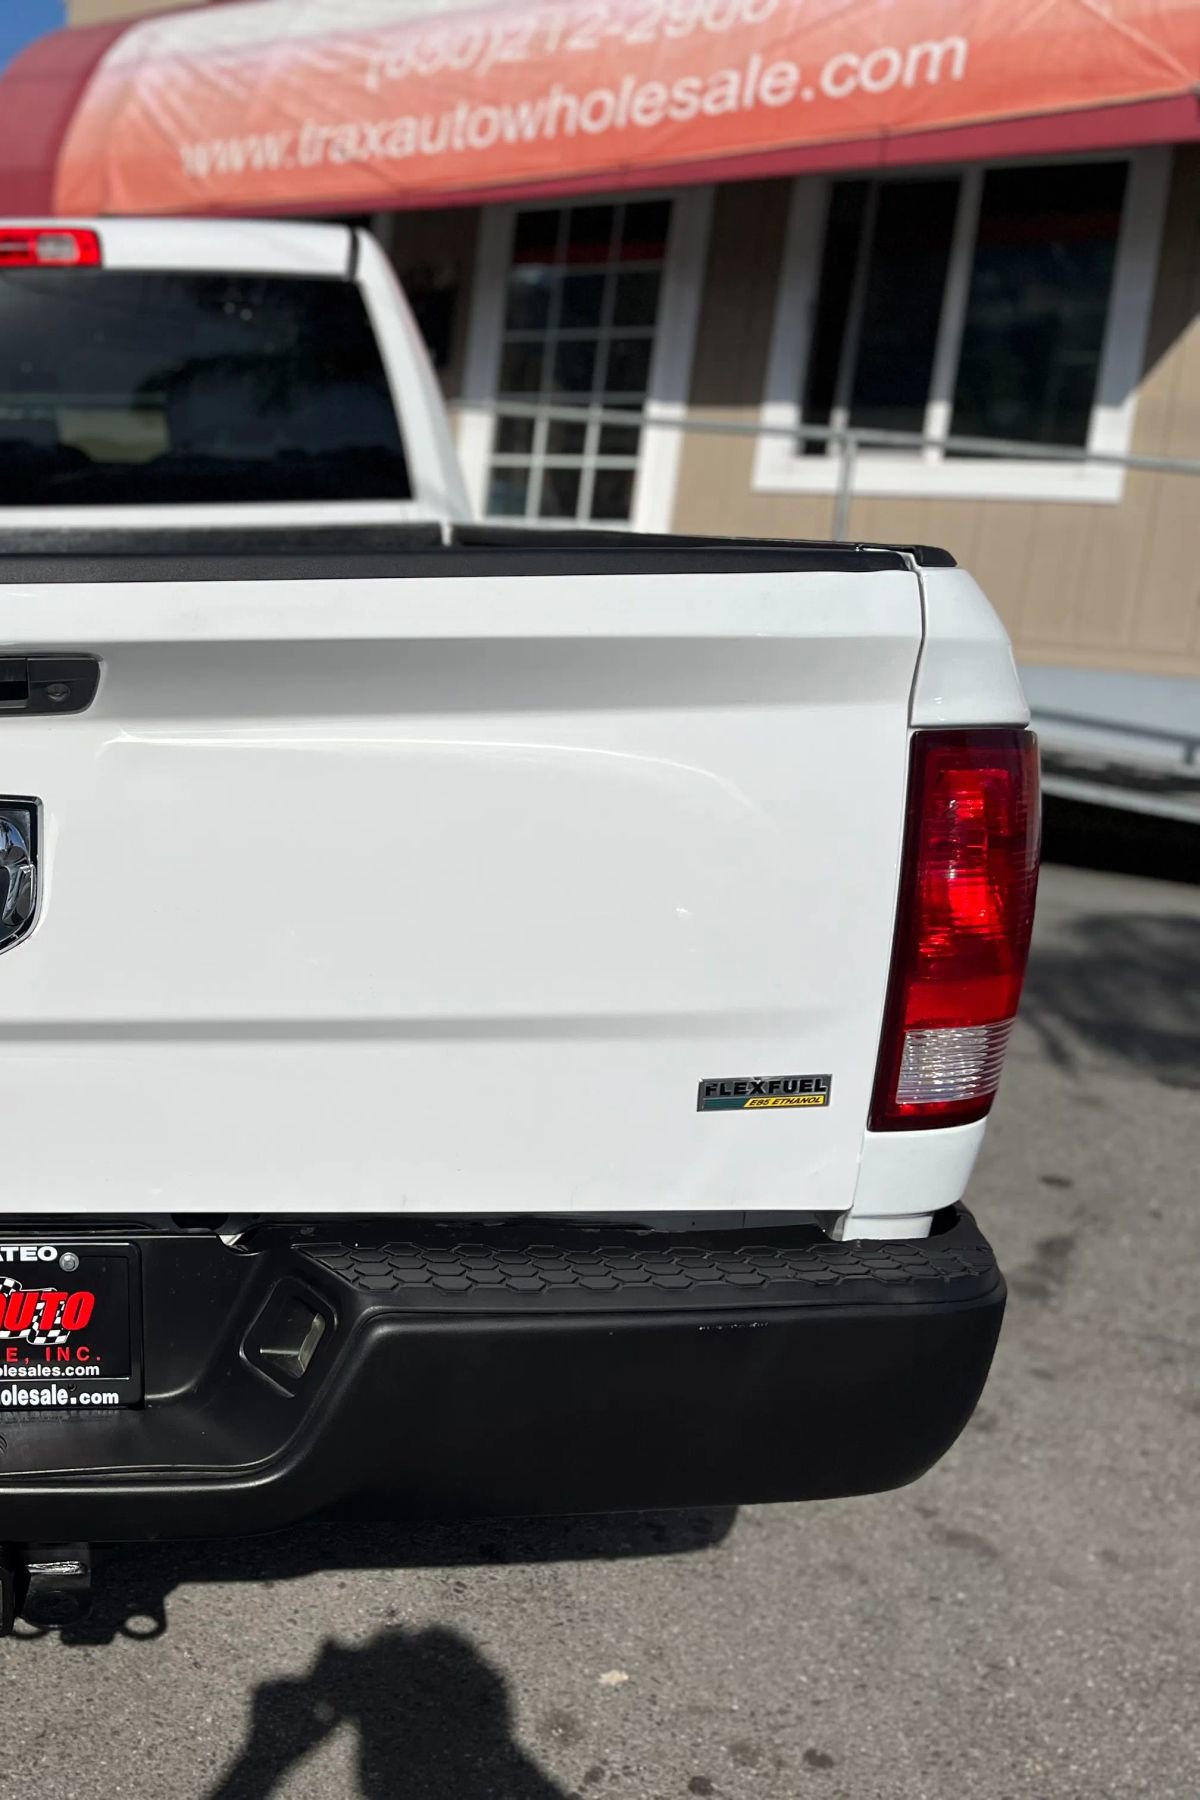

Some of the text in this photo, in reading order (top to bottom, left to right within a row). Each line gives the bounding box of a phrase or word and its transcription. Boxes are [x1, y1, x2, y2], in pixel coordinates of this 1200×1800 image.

[179, 35, 969, 177] www.traxautowholesale.com
[705, 1079, 827, 1096] FLEXFUEL
[772, 1096, 822, 1105] ETHANOL
[46, 1346, 101, 1361] INC.
